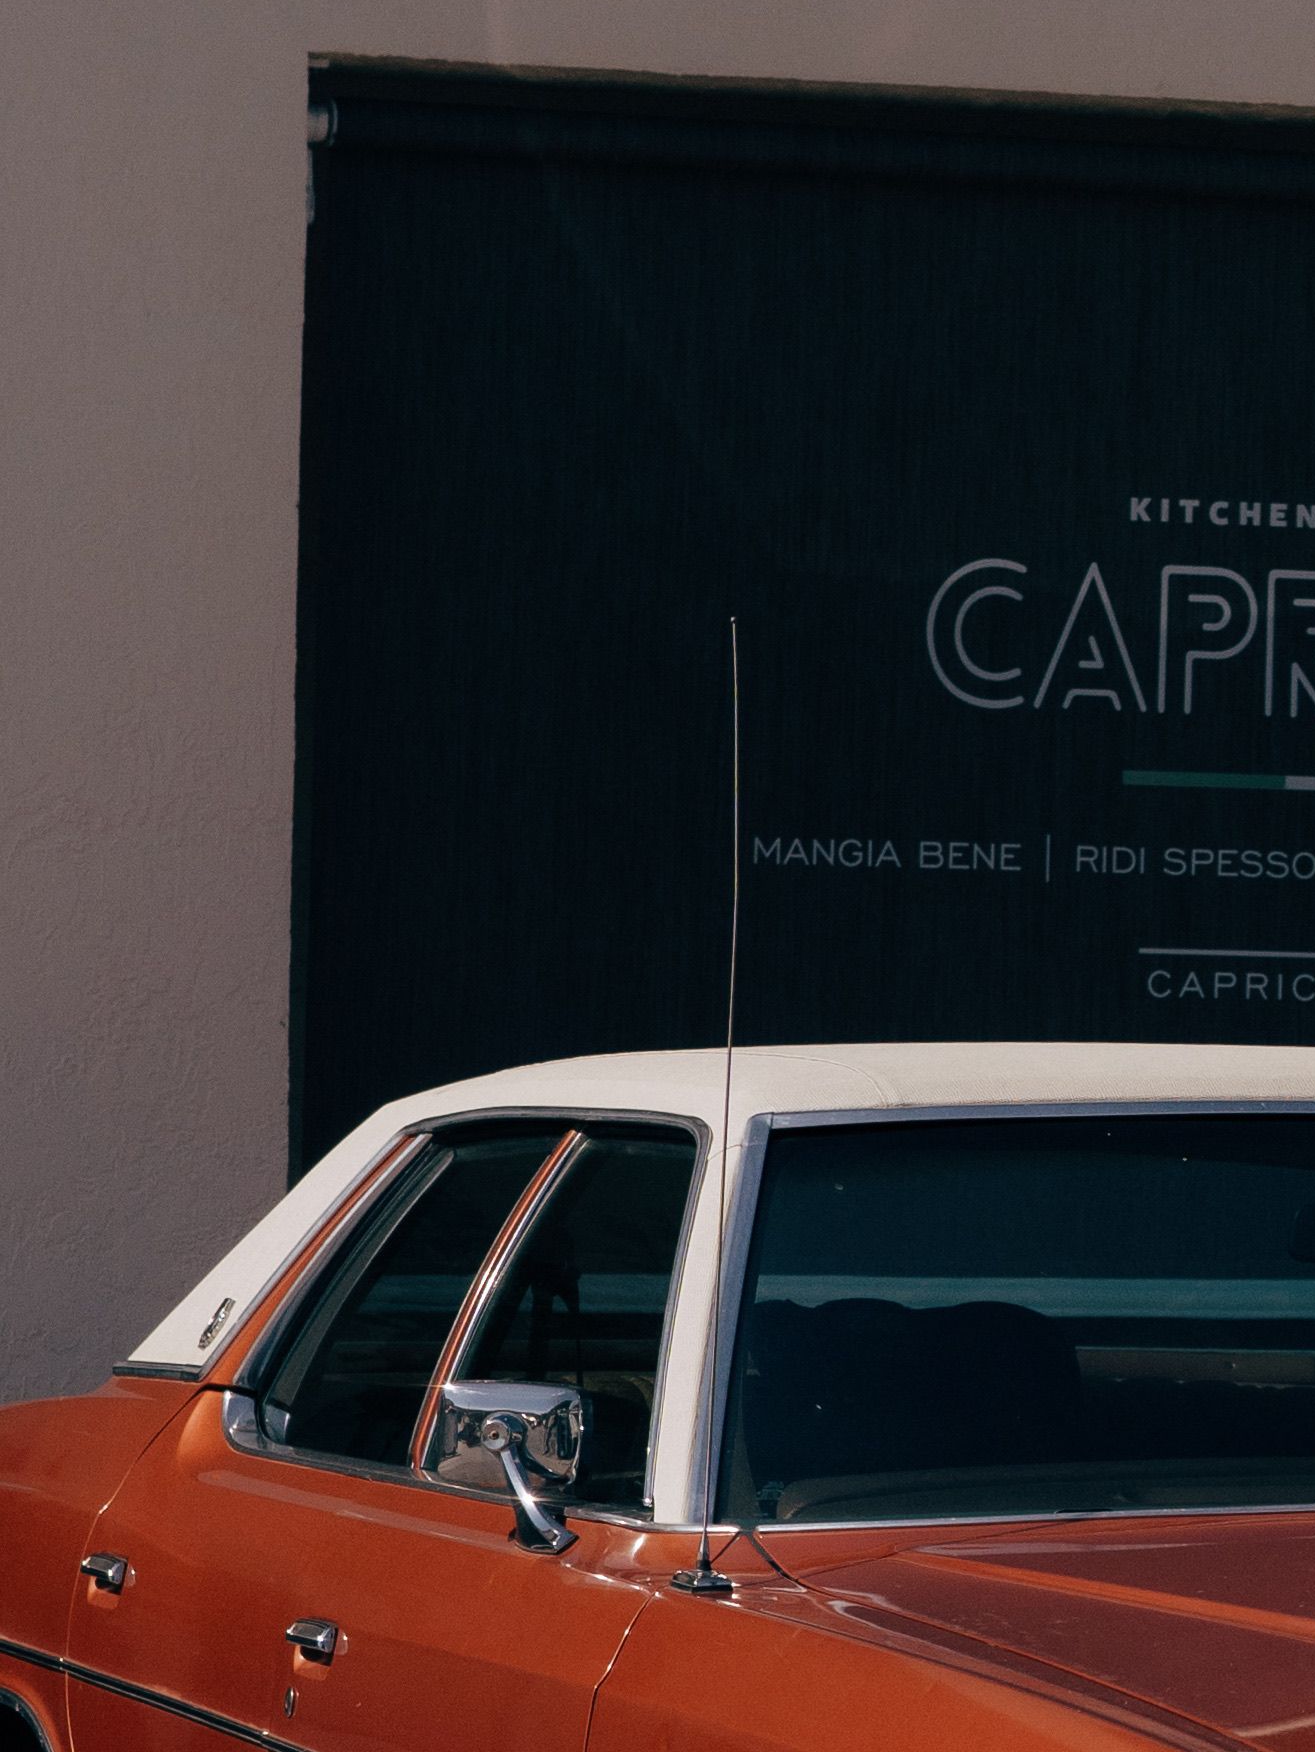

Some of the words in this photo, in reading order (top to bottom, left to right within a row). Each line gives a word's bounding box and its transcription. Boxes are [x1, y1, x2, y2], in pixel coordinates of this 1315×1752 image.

[752, 836, 901, 869] MANGIA
[919, 840, 1022, 872] BENE
[1076, 845, 1151, 876] RIDI
